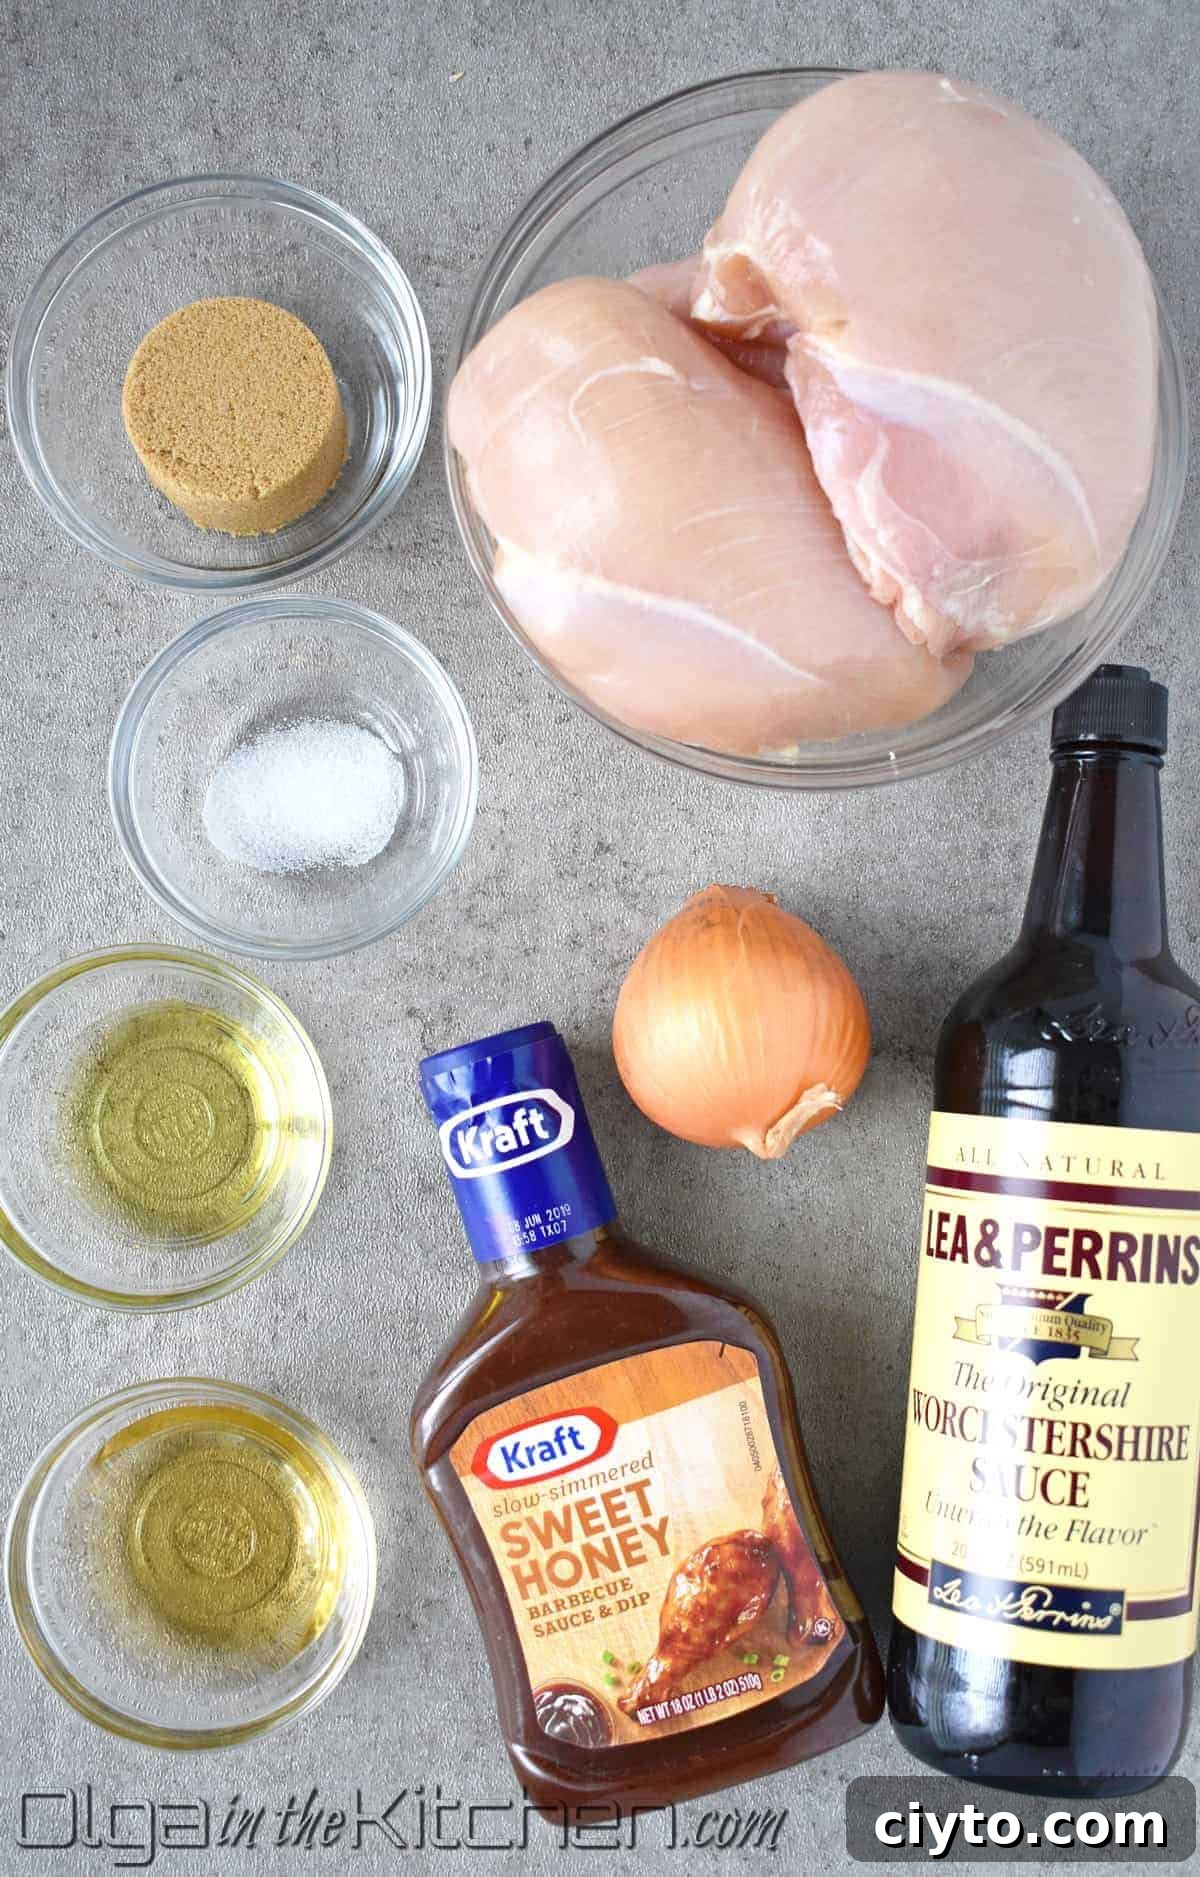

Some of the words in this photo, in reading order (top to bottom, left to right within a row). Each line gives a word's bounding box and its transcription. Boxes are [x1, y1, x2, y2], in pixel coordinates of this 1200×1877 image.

[456, 1108, 549, 1165] Kraft
[955, 1146, 996, 1166] ALL
[546, 1203, 572, 1222] 2019
[1064, 1313, 1108, 1335] Quality
[953, 1359, 995, 1392] The
[500, 1424, 585, 1474] Kraft
[493, 1450, 655, 1519] slow-simmered
[500, 1478, 652, 1559] SWEET
[1017, 1513, 1059, 1539] the
[1063, 1517, 1148, 1546] Flavor
[511, 1515, 671, 1601] HONEY
[1018, 1552, 1089, 1581] (591mL)
[526, 1577, 634, 1620] BARBECUE
[533, 1608, 595, 1638] SAUCE
[599, 1603, 613, 1619] &
[616, 1591, 651, 1615] DIP
[636, 1705, 657, 1725] NET
[655, 1701, 672, 1720] WT
[670, 1698, 684, 1715] 18
[681, 1693, 697, 1711] OZ
[703, 1686, 718, 1704] LB
[715, 1683, 726, 1700] 2
[738, 1673, 762, 1691] 510g
